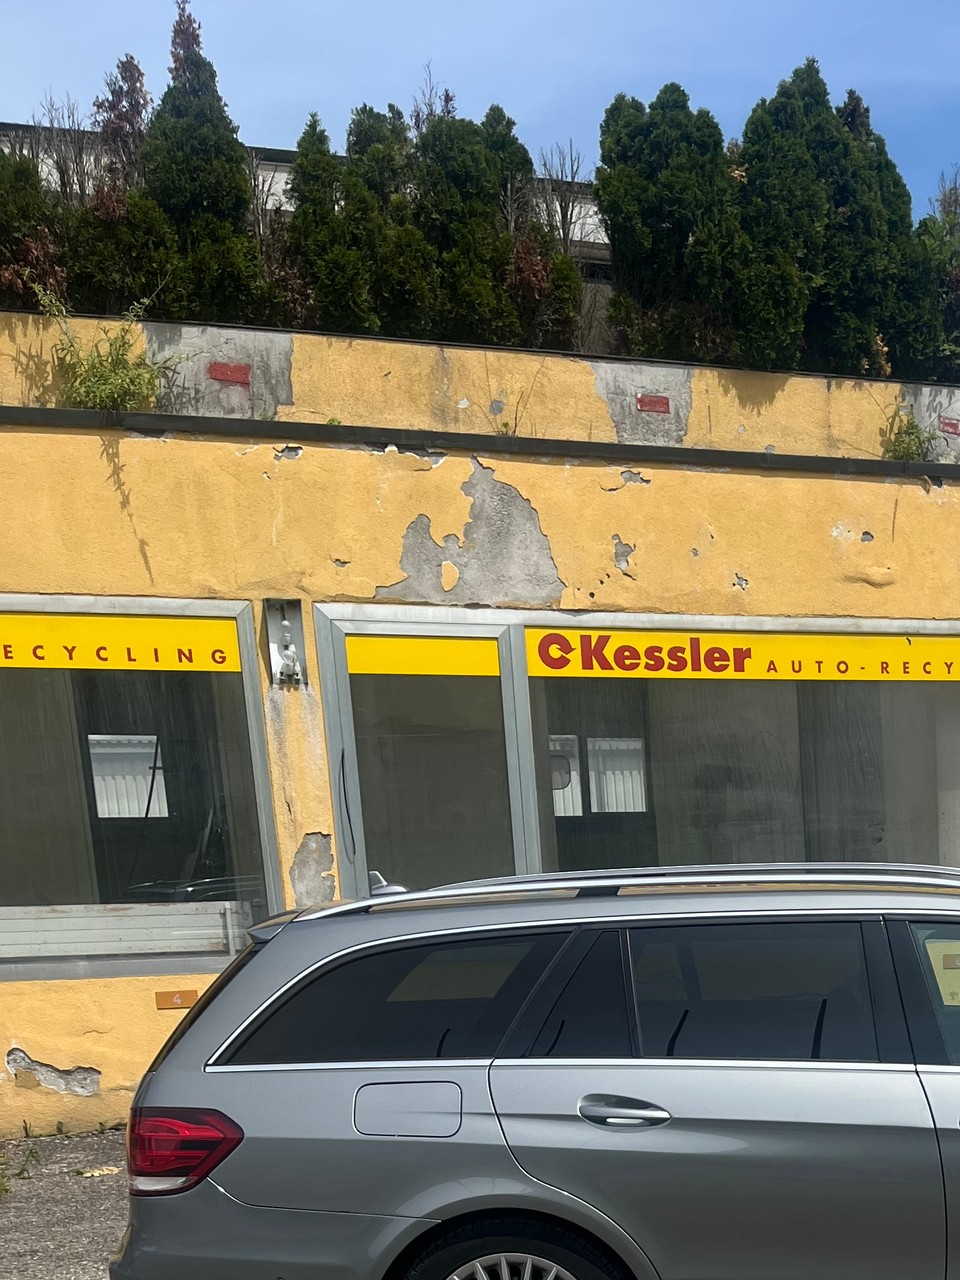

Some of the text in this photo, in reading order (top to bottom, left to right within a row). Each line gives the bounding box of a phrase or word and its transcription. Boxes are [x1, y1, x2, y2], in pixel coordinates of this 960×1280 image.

[2, 644, 228, 664] ECYCLING
[580, 634, 752, 673] Kessler
[173, 993, 182, 1004] 4
